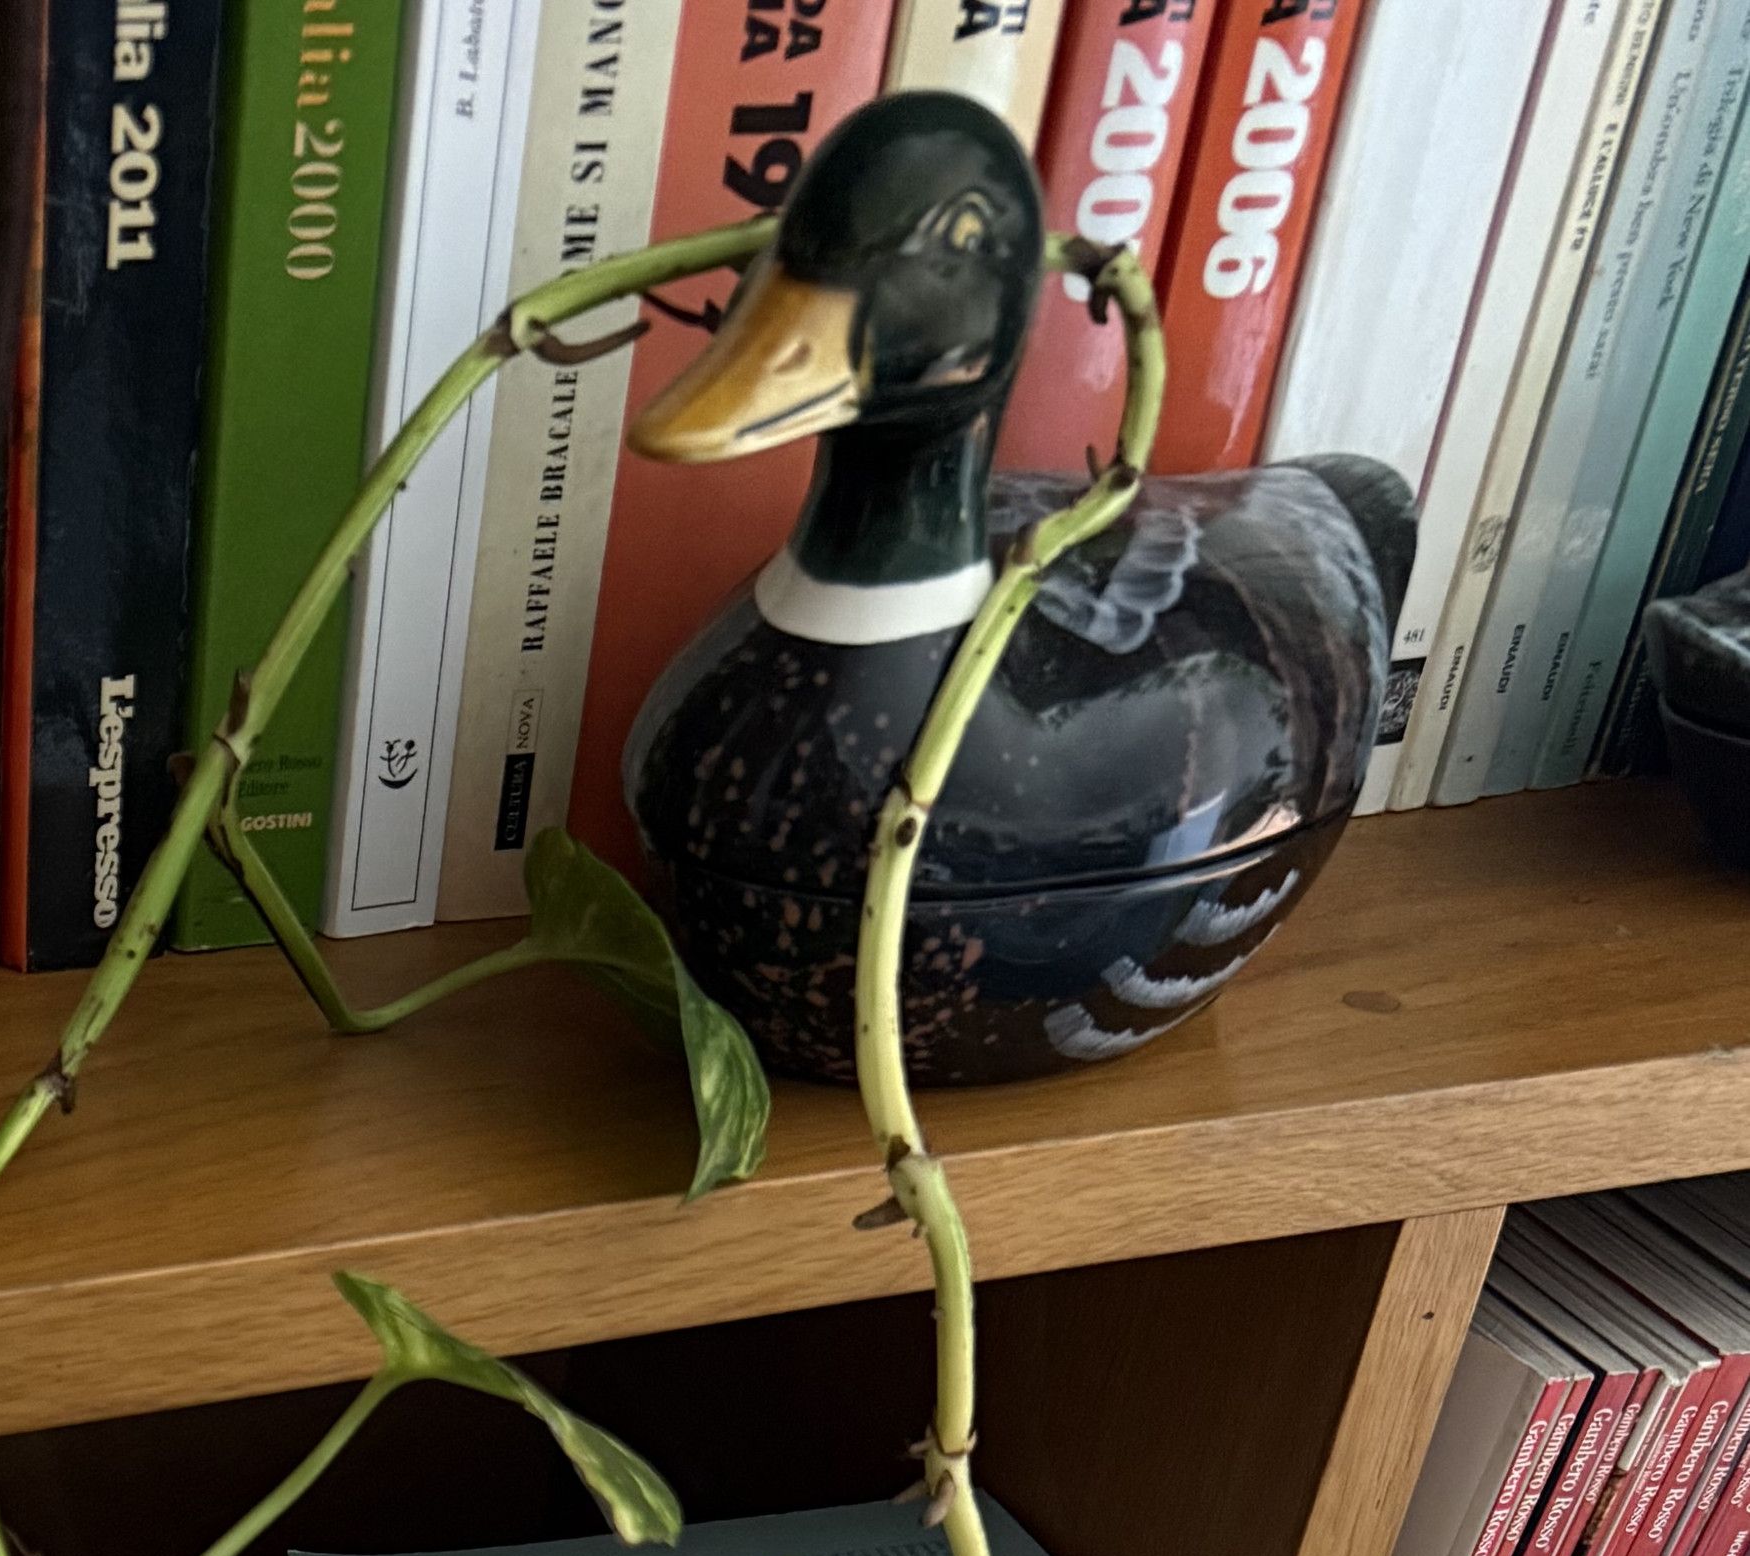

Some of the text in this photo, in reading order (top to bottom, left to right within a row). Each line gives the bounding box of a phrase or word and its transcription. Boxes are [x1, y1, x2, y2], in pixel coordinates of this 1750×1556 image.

[106, 102, 163, 271] 2011
[282, 121, 346, 282] 2000
[1064, 40, 1184, 300] 200
[1203, 38, 1325, 298] 2006
[517, 369, 579, 652] RAFFAELE BRACALE
[1440, 645, 1464, 710] EINAUDI
[1497, 624, 1525, 693] EINAUDI
[78, 672, 136, 929] L'espresso
[1497, 1417, 1547, 1505] Gambero
[1534, 1404, 1613, 1555] Gambero Rosso
